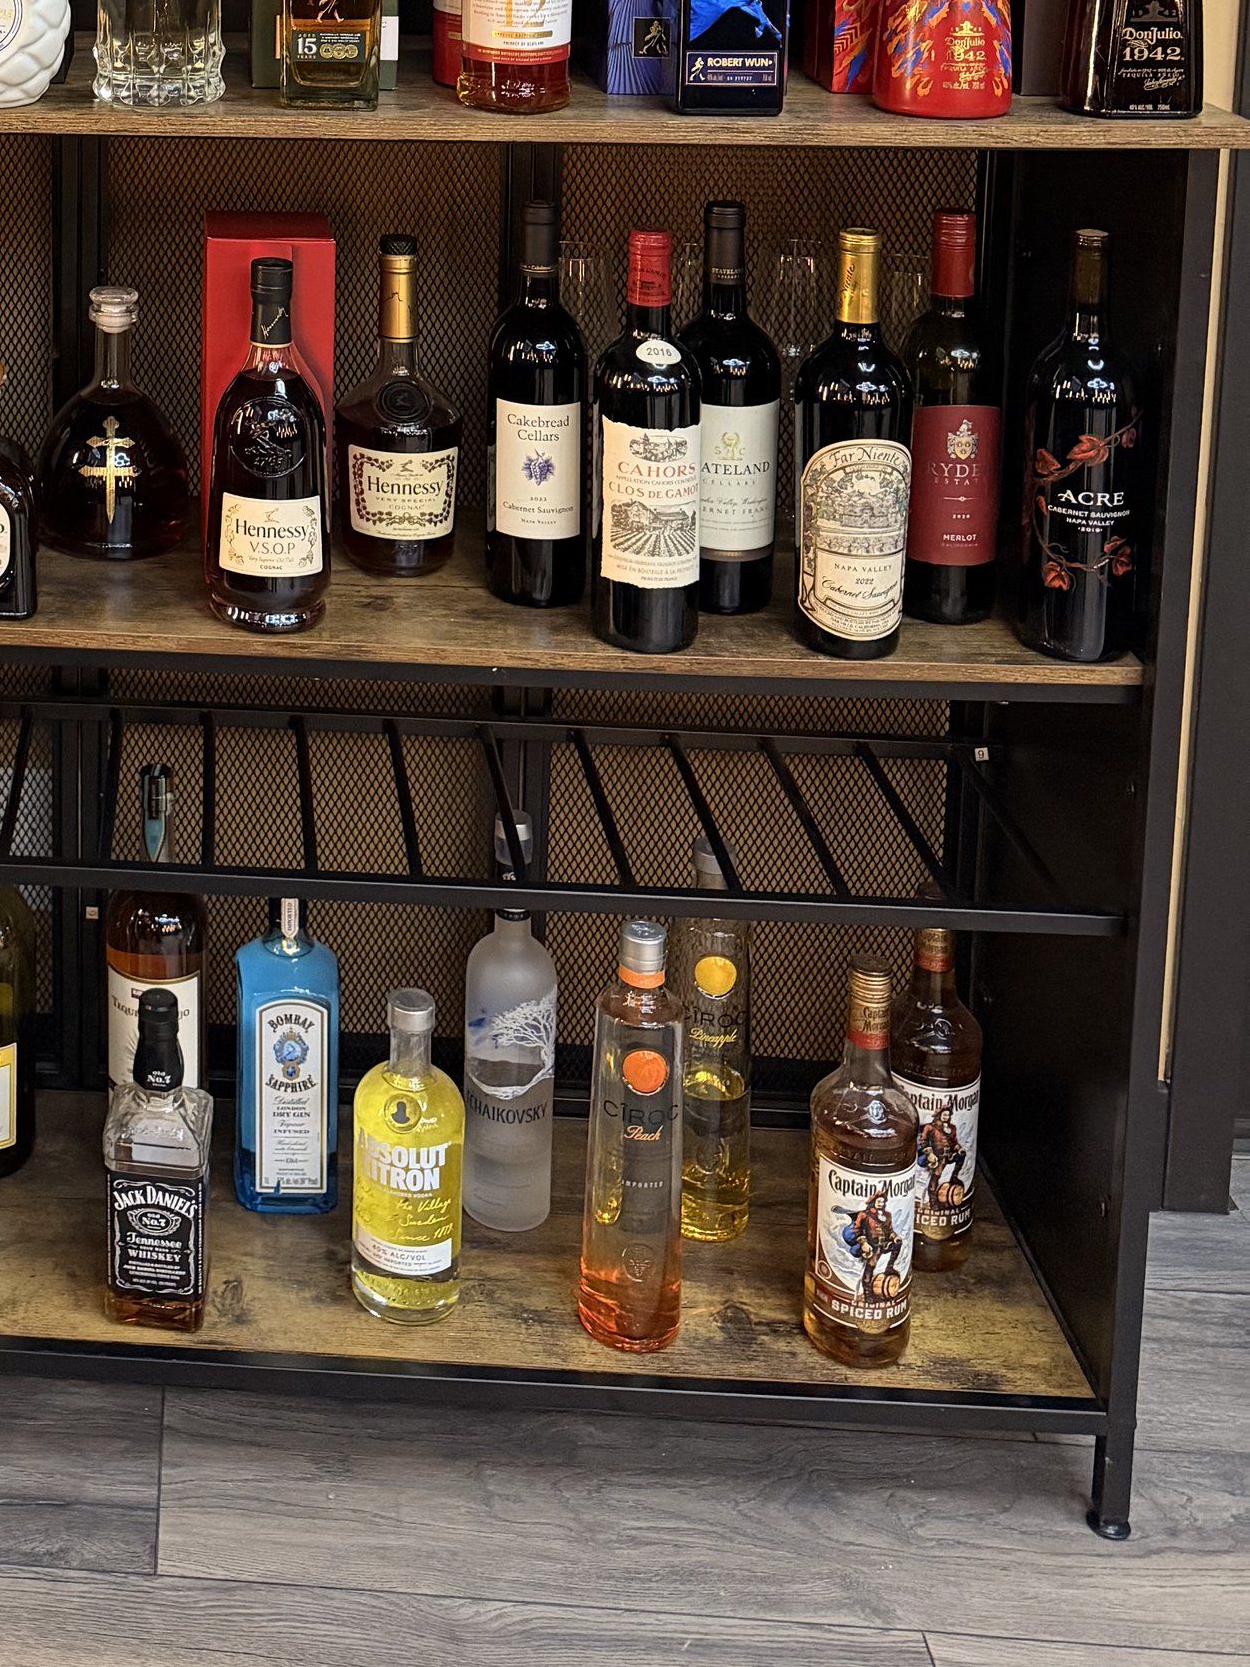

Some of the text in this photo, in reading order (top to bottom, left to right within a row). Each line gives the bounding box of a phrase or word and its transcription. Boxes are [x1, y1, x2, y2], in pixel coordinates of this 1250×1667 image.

[296, 37, 318, 55] 15
[1122, 45, 1185, 62] 1942
[707, 57, 769, 67] ROBERT WUN
[645, 346, 673, 358] 2016
[507, 412, 570, 429] Cakebread
[517, 428, 561, 443] Cellars
[828, 446, 900, 468] Far Niente
[617, 460, 697, 479] CAHORS
[366, 474, 445, 498] Hennessy
[607, 480, 663, 500] CLOS DE
[375, 495, 437, 504] VERY SPECIAL
[1057, 489, 1125, 508] ACRE
[502, 501, 574, 515] Cabernet Sauvignon
[1047, 504, 1131, 519] CABERNET SAUVIGNON
[234, 518, 310, 542] Hennessy
[1066, 516, 1115, 527] NAPA VALLEY
[942, 533, 978, 543] MERLOT
[248, 540, 297, 555] V.S.O.P
[259, 563, 284, 571] COGNAC
[834, 562, 893, 573] NAPA VALLEY
[820, 575, 863, 599] Cabernet
[266, 1012, 316, 1035] BOMBAY
[688, 1026, 739, 1050] Pineapple
[265, 1073, 318, 1096] SAPPHIRE
[272, 1110, 312, 1119] DRY GIN
[273, 1127, 311, 1135] INFUSED
[623, 1124, 664, 1143] Peach
[356, 1125, 450, 1171] ABSOLUT
[362, 1155, 441, 1193] CITRON
[827, 1168, 917, 1201] Captain Morgan
[112, 1185, 199, 1219] JACK DANIEL'S
[146, 1211, 161, 1220] Old
[125, 1231, 183, 1250] Tennessee
[126, 1247, 182, 1263] WHISKEY
[830, 1297, 908, 1321] SPICED RUM
